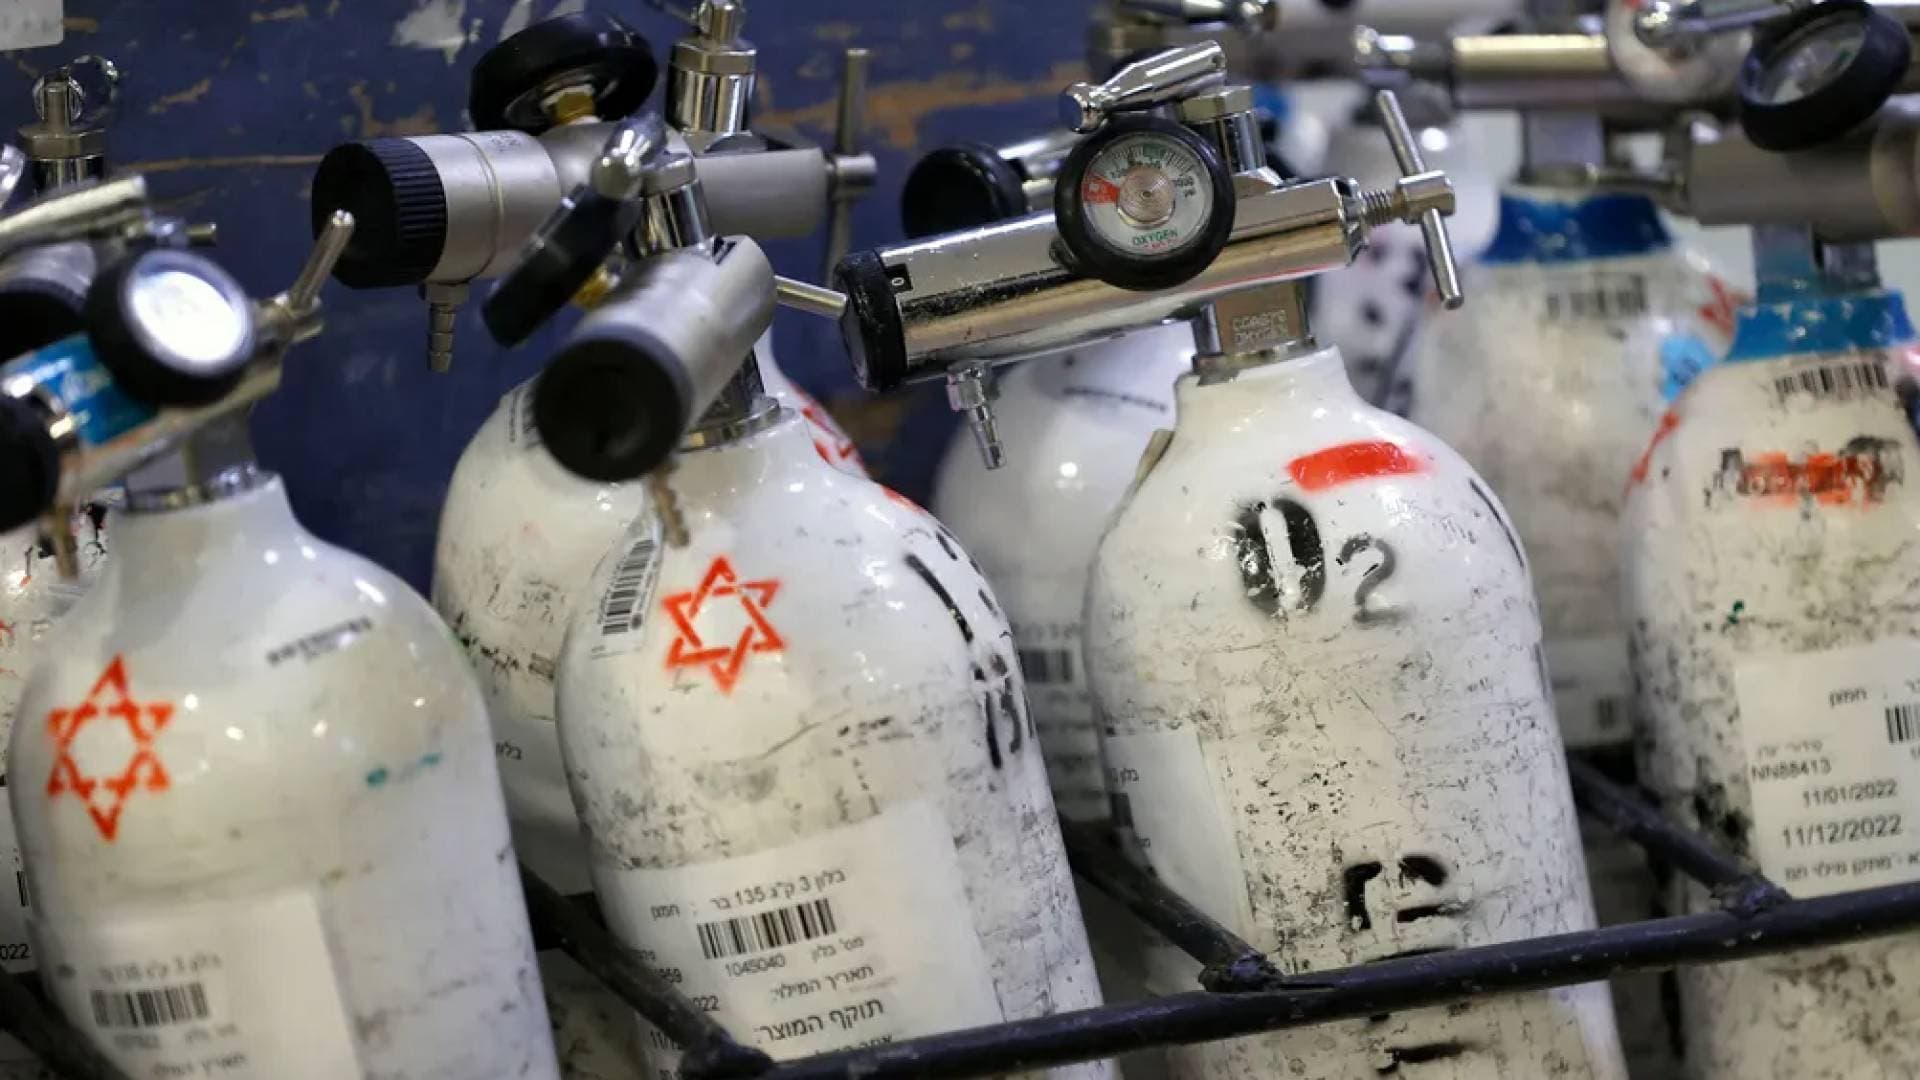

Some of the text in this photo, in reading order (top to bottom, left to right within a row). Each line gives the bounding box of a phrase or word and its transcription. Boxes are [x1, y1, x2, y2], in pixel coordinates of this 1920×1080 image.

[1131, 229, 1178, 246] OXYGEN
[1803, 778, 1898, 807] 11/01/2022
[1783, 813, 1903, 849] 11/12/2022
[735, 886, 766, 904] 135
[799, 876, 811, 891] 3
[824, 965, 874, 991] תאריך
[828, 998, 884, 1030] תוקף
[753, 1015, 825, 1044] המוצר:
